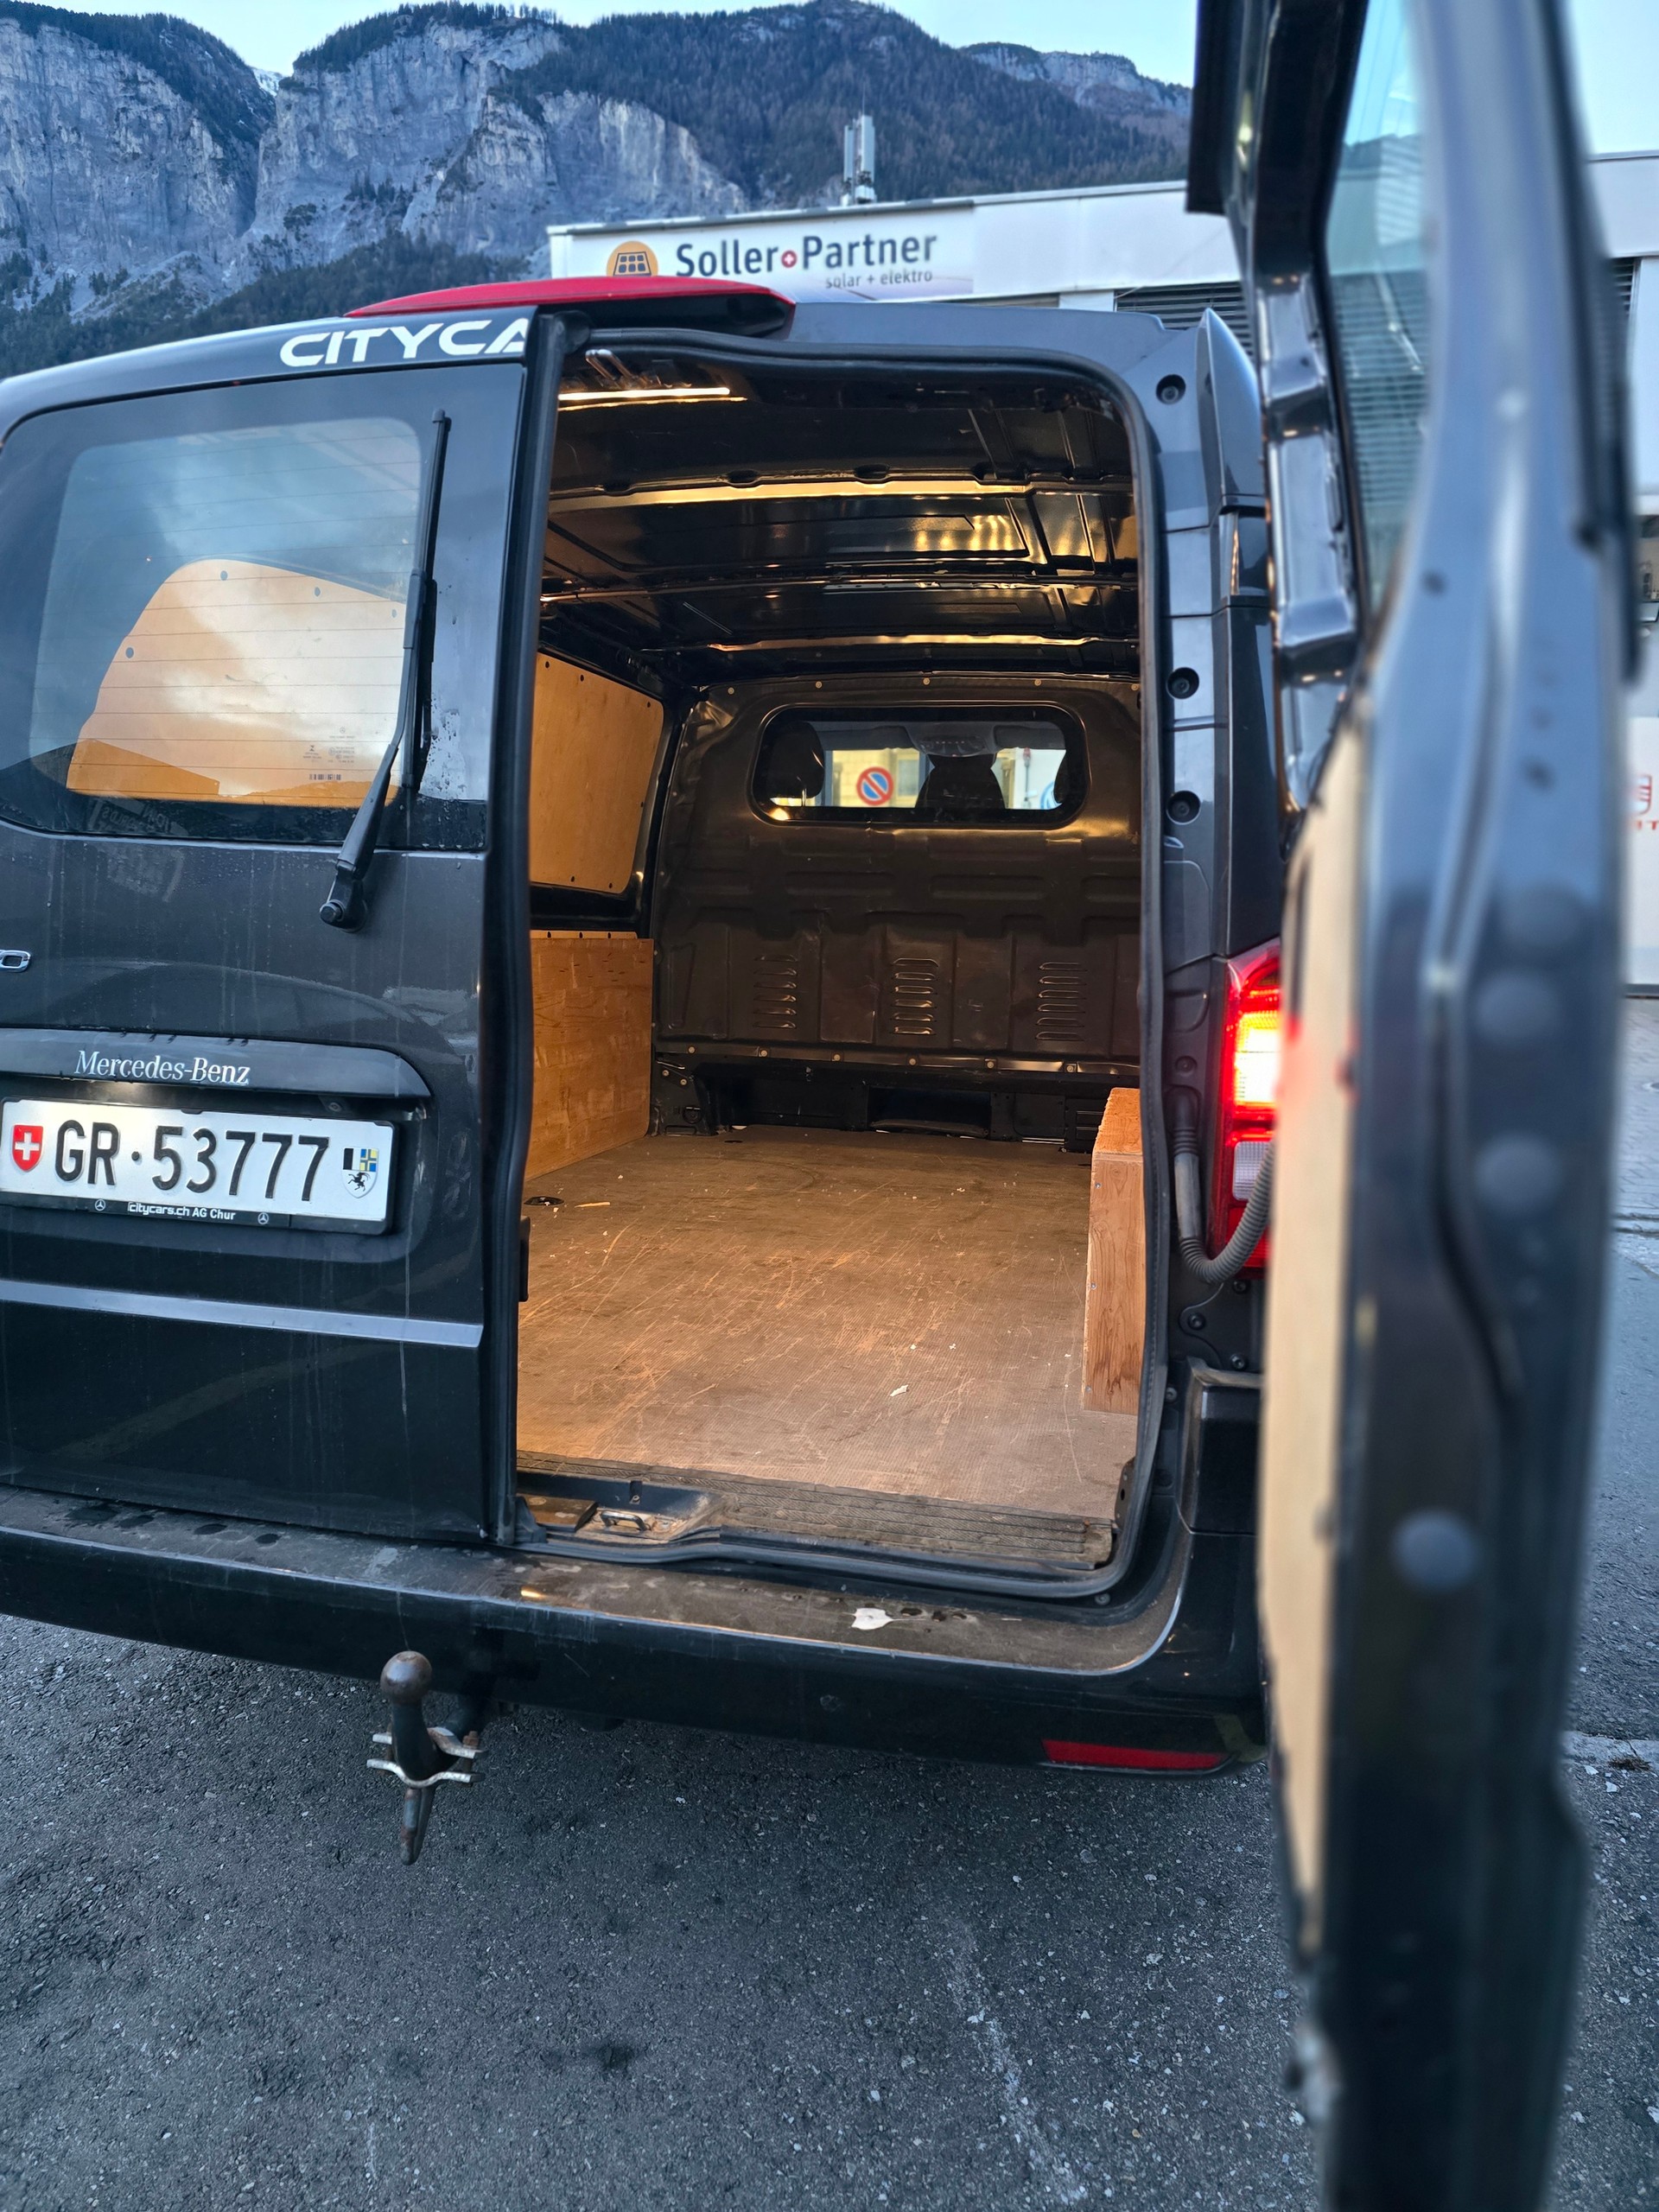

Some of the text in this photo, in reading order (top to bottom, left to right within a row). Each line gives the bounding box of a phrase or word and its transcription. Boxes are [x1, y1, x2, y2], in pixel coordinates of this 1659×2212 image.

[676, 234, 938, 277] Soller Partner
[825, 274, 861, 289] solar
[880, 270, 932, 285] elektro
[74, 1049, 251, 1086] Mercedes-Benz
[128, 1201, 236, 1220] citycars.ch AG Chur
